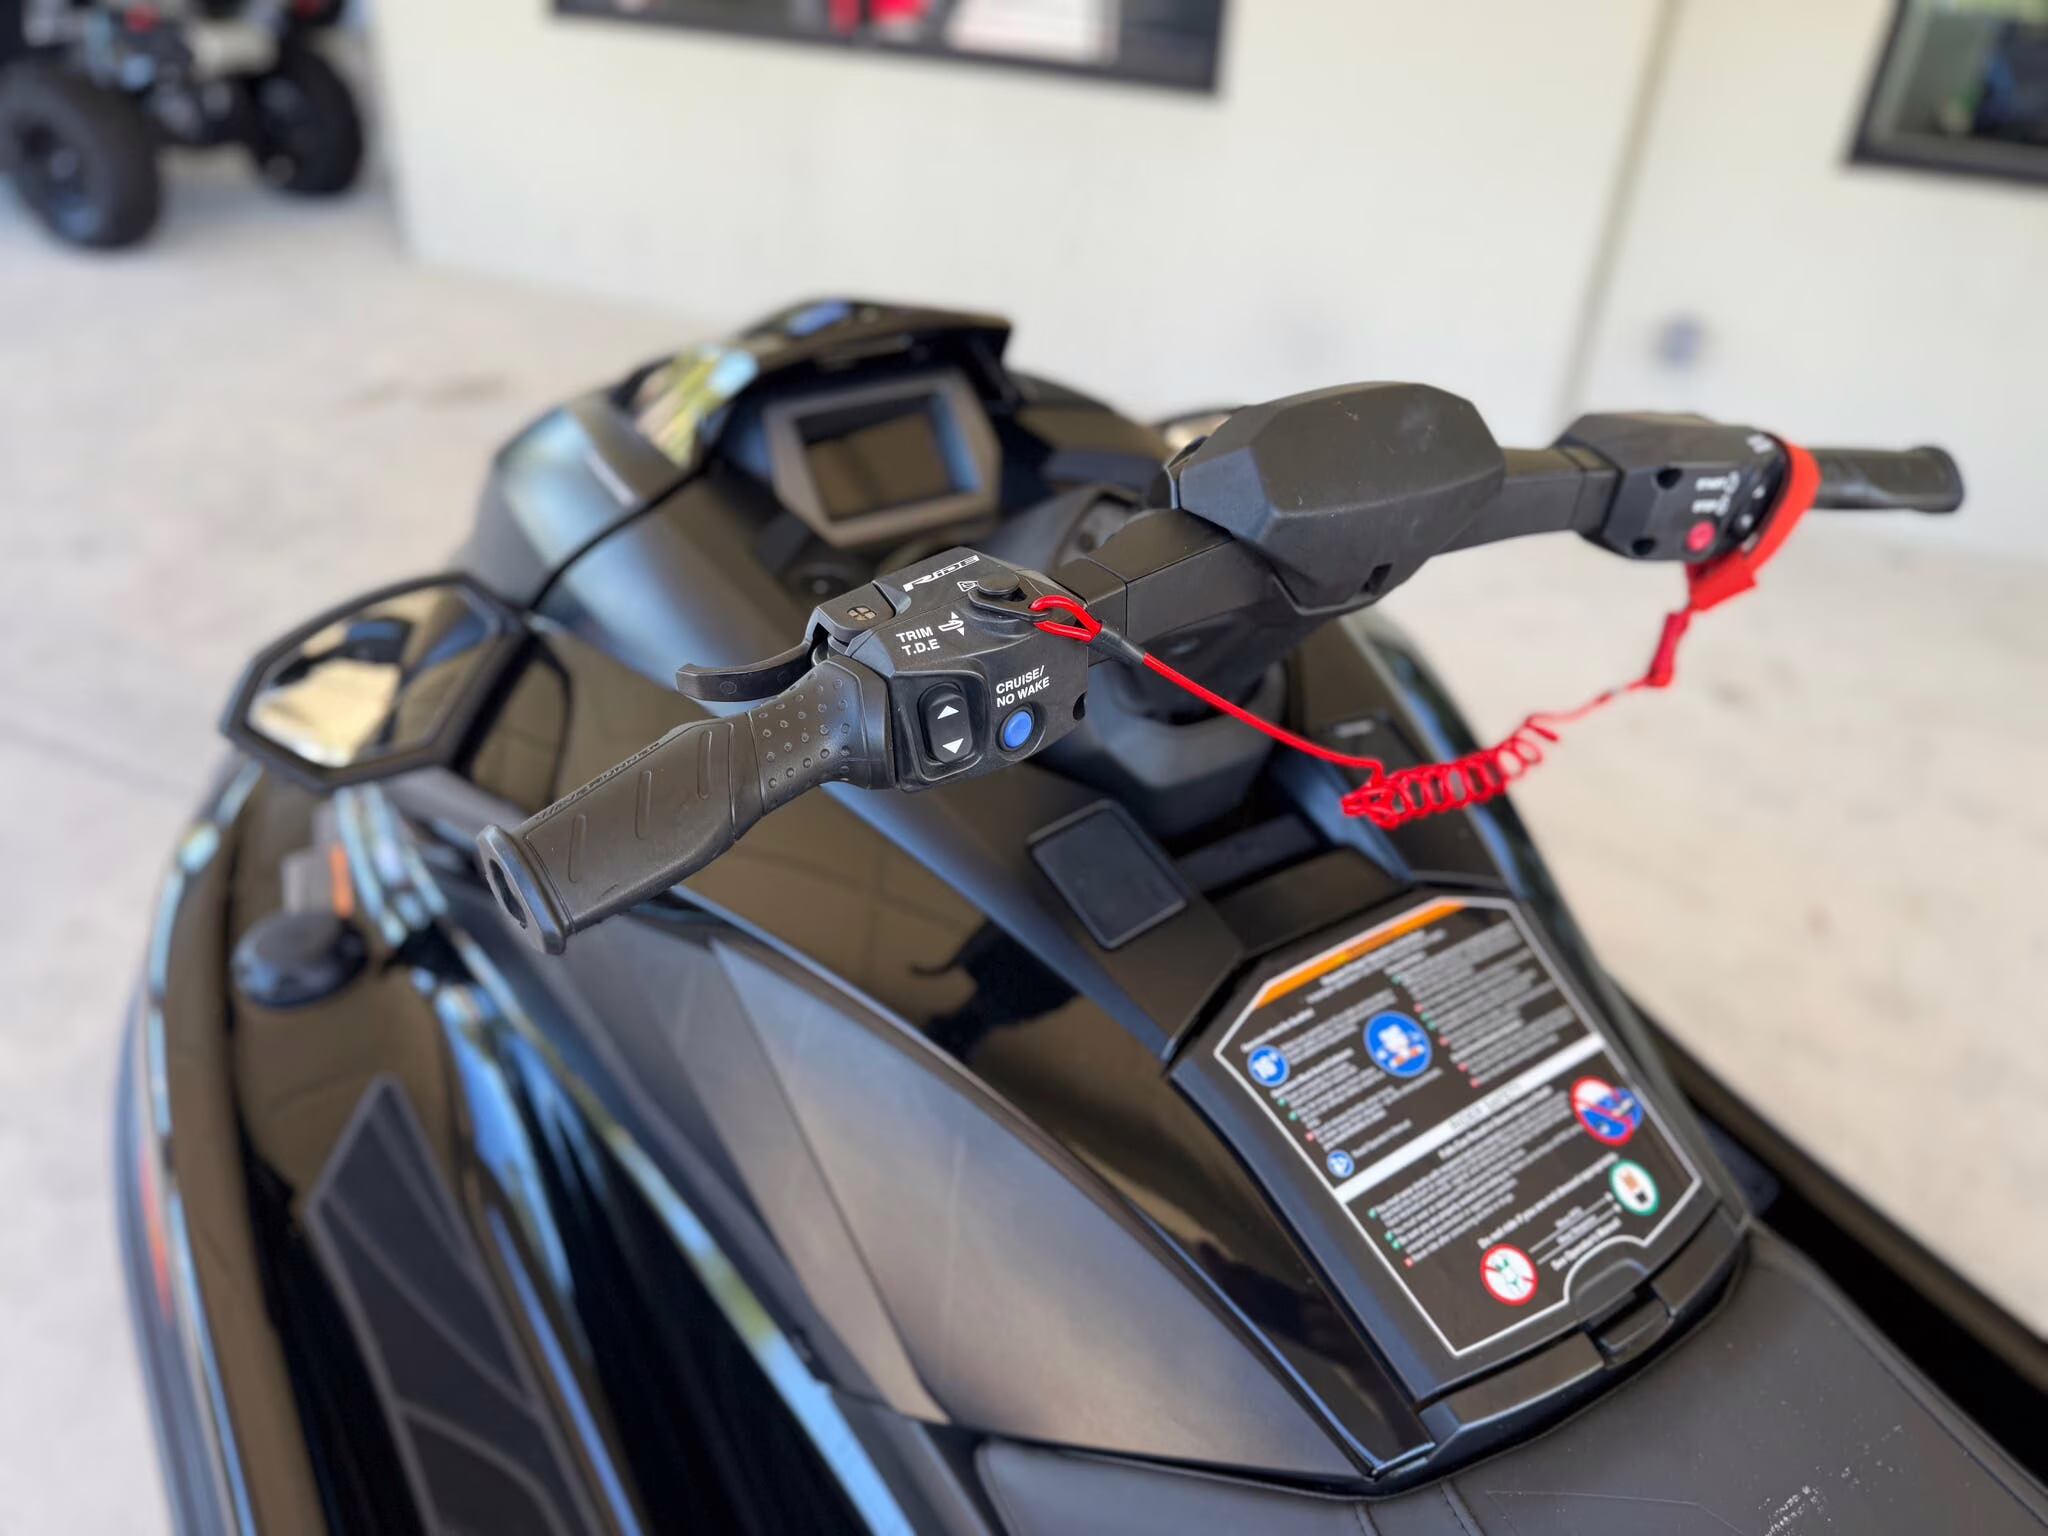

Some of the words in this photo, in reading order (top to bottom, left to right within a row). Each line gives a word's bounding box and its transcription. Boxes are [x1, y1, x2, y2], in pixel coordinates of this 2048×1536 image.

[895, 626, 934, 644] TRIM
[900, 638, 940, 656] T.D.E
[995, 665, 1045, 695] CRUISE/
[996, 693, 1016, 708] NO
[1017, 676, 1051, 700] WAKE
